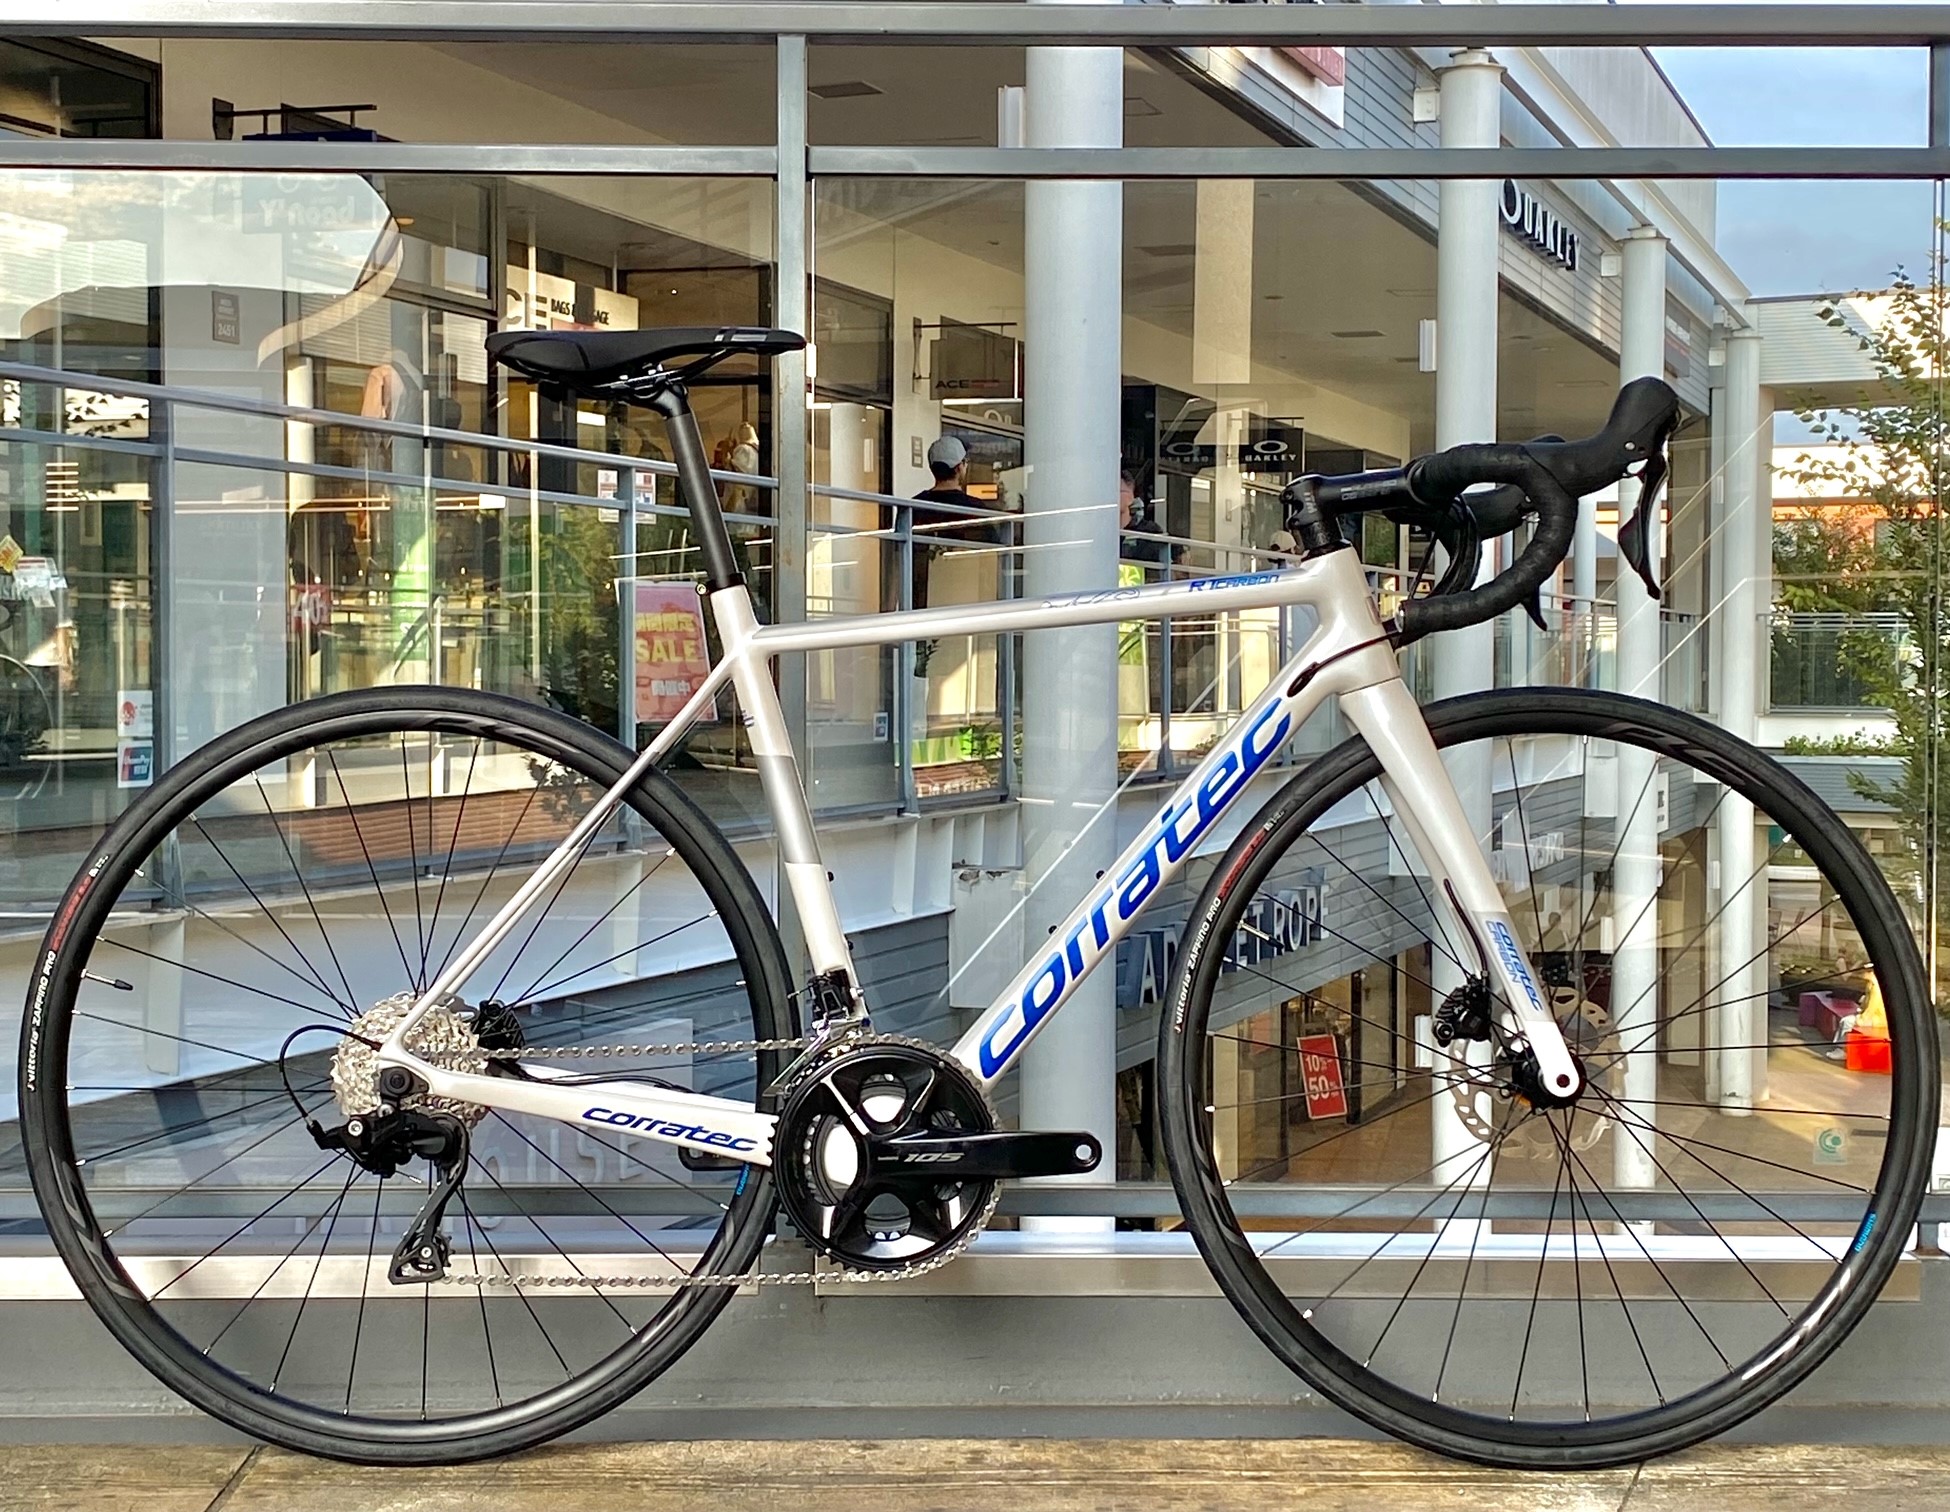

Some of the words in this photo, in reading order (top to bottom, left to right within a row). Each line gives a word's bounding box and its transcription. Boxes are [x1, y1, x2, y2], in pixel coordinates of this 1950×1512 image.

[550, 298, 570, 316] BAGS
[935, 380, 969, 389] ACE
[1244, 454, 1297, 462] OAKLEY
[636, 639, 699, 662] SALE
[980, 697, 1291, 1079] corratec
[581, 1107, 759, 1152] corratec
[903, 1152, 966, 1163] 105
